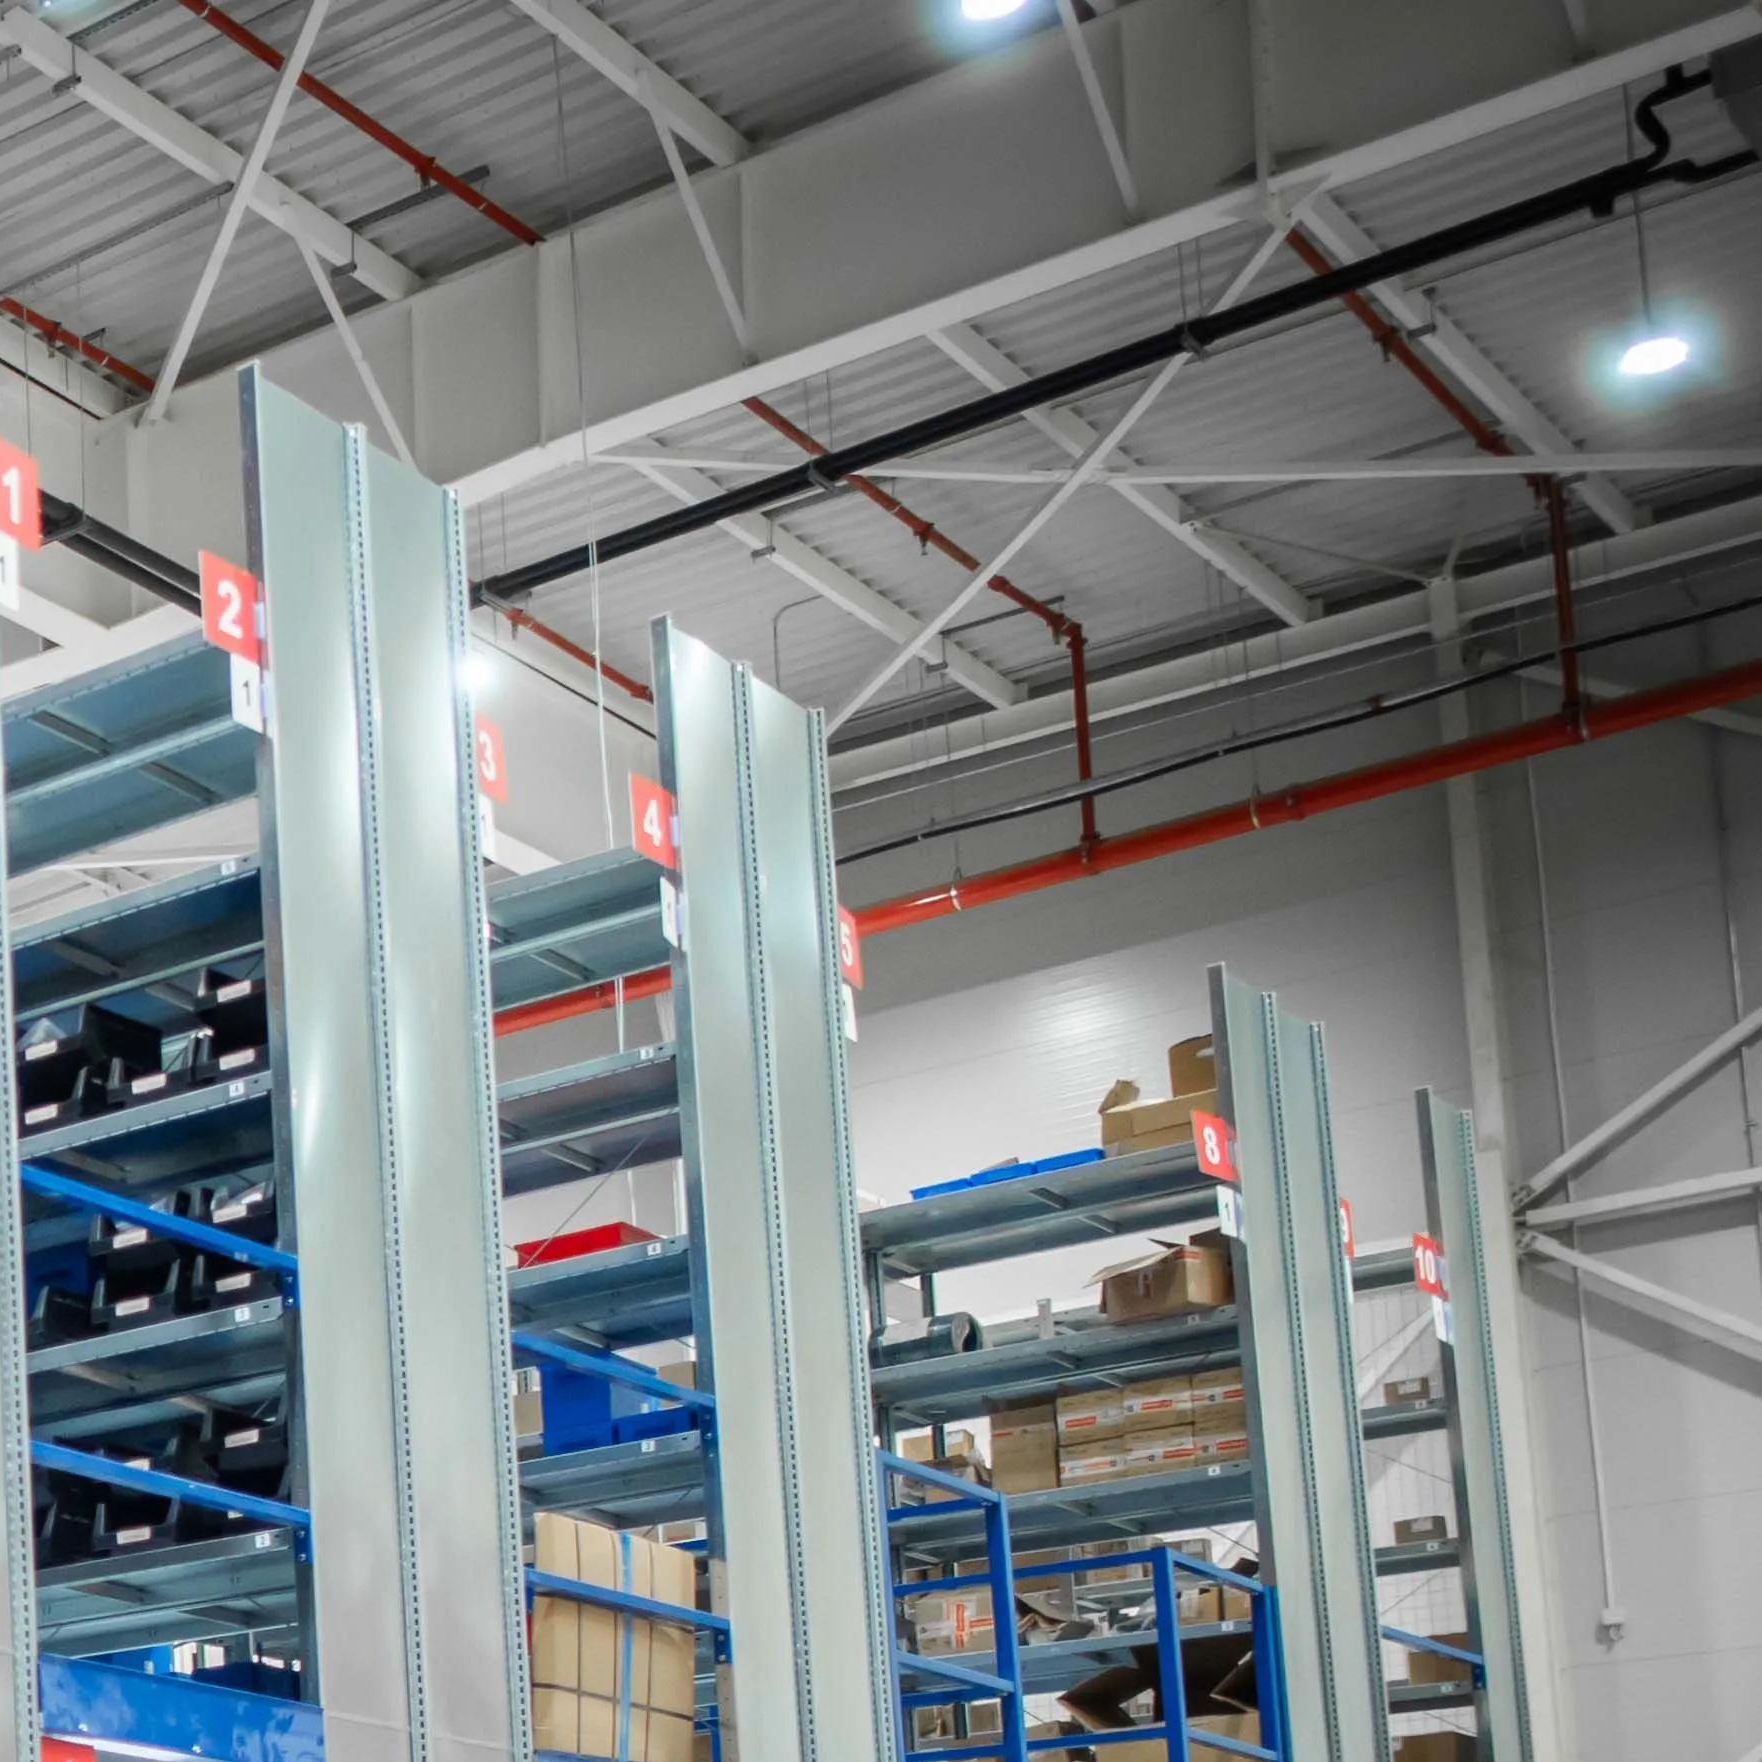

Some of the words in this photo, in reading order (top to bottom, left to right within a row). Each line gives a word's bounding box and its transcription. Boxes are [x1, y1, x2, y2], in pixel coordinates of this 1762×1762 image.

[2, 466, 20, 524] 1
[217, 580, 243, 640] 2
[242, 680, 250, 708] 1
[478, 731, 496, 783] 3
[643, 799, 661, 846] 4
[840, 922, 853, 967] 5
[1203, 1125, 1220, 1165] 8
[1415, 1245, 1436, 1284] 10
